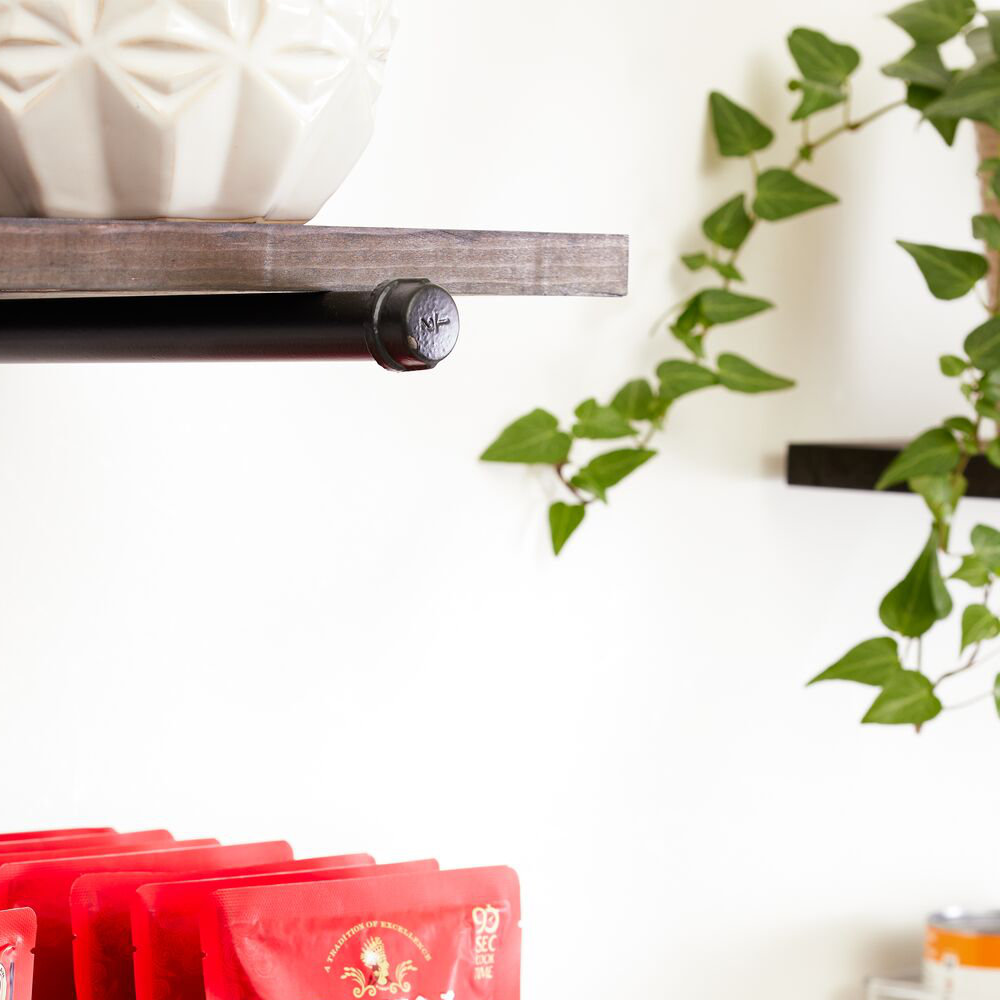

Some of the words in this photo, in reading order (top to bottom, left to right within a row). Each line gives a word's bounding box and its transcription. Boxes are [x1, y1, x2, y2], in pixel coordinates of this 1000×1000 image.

[327, 922, 366, 963] TRADITION
[365, 920, 379, 930] OF
[380, 920, 433, 962] EXCELLENCE
[474, 934, 498, 953] SEC
